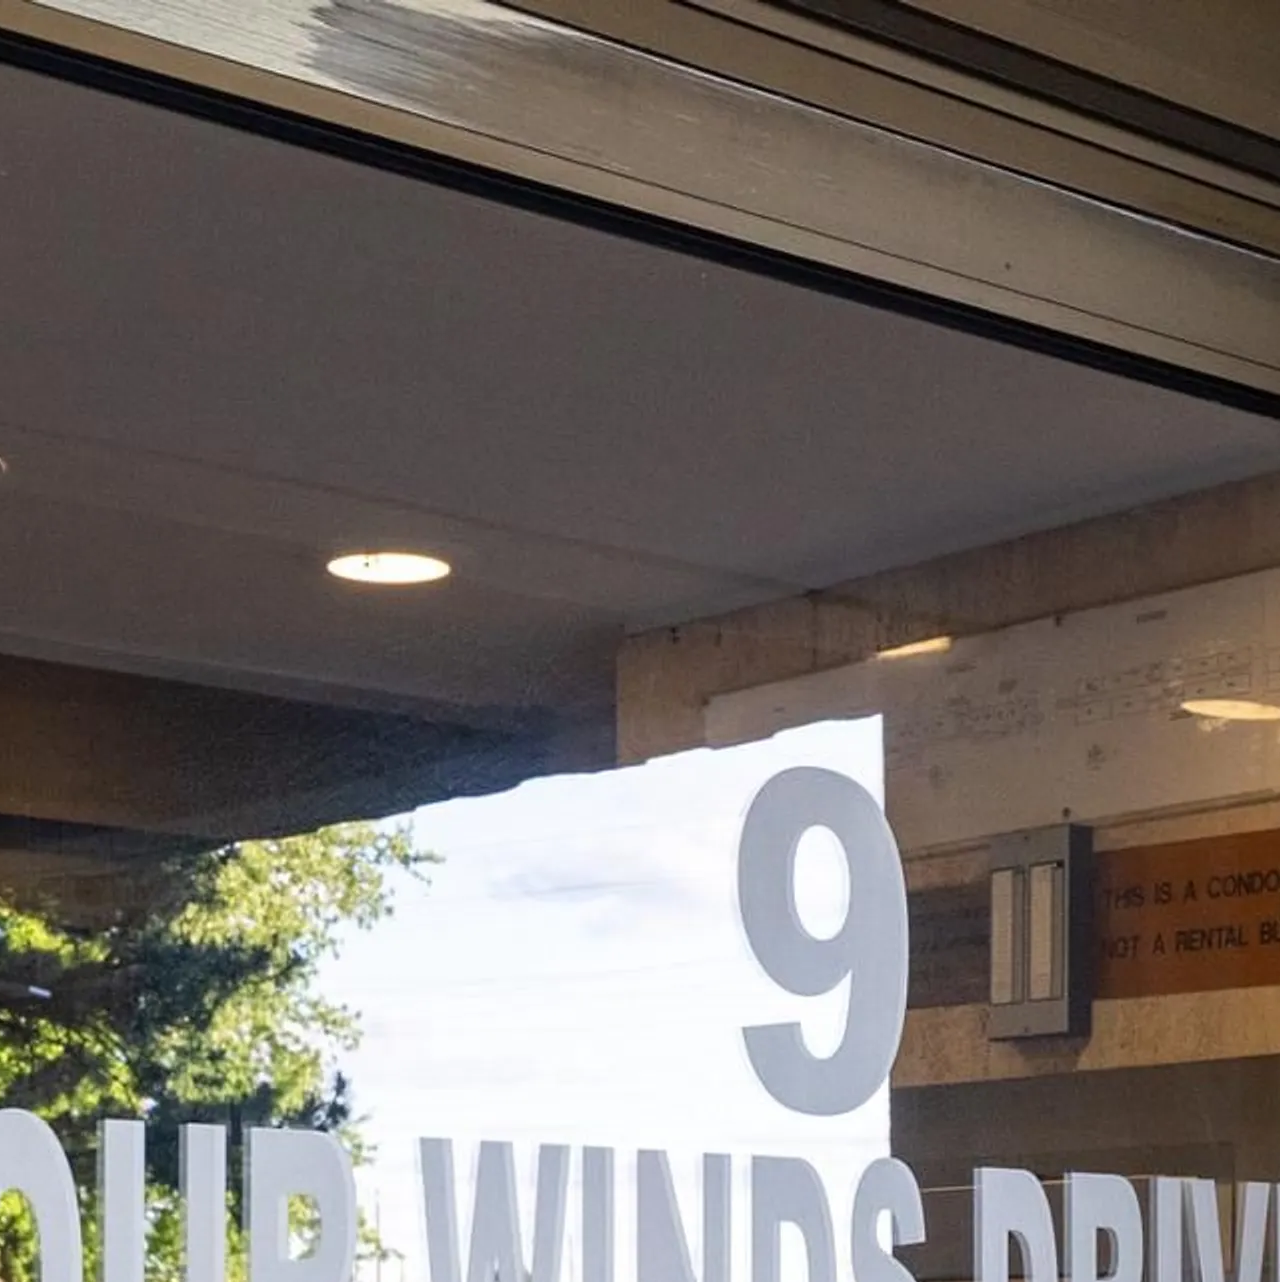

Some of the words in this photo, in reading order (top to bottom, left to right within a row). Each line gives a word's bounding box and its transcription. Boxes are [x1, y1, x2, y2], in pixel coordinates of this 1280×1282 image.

[1101, 884, 1144, 909] THIS
[1154, 881, 1173, 905] IS
[1183, 879, 1199, 903] A
[737, 765, 910, 1117] 9
[1101, 933, 1142, 961] NOT
[1152, 931, 1167, 956] A
[1175, 924, 1248, 953] RENTAL
